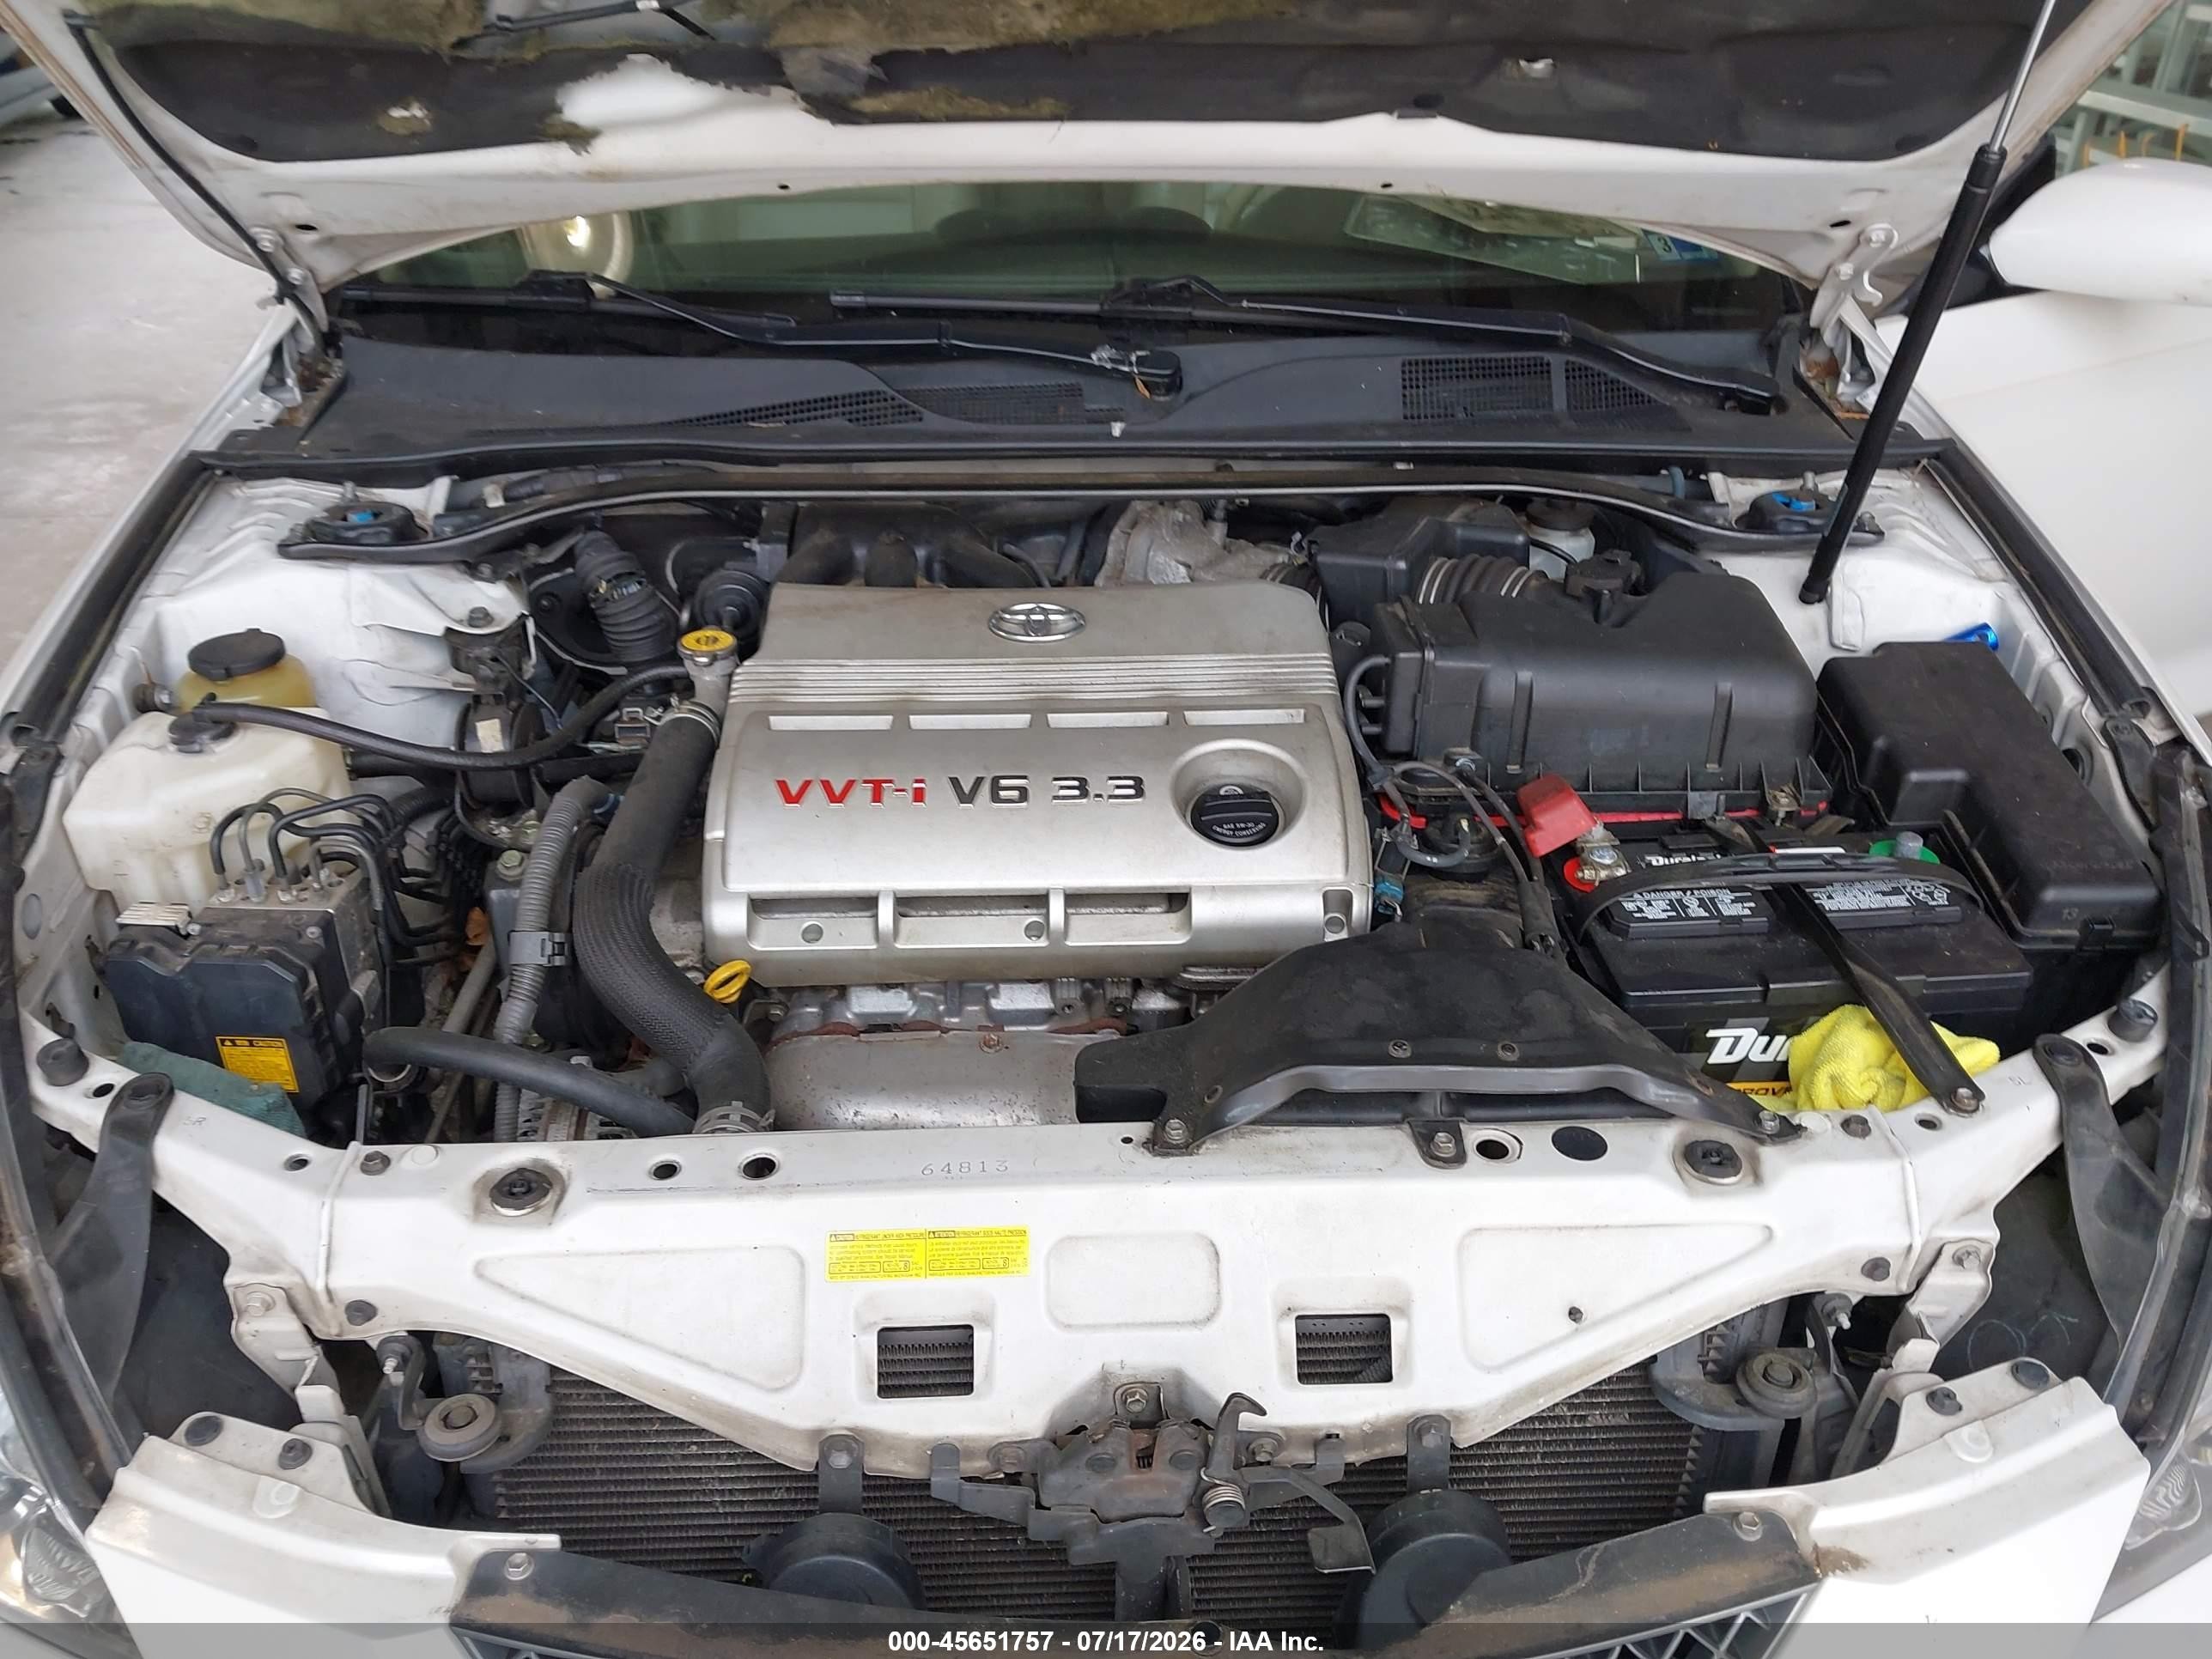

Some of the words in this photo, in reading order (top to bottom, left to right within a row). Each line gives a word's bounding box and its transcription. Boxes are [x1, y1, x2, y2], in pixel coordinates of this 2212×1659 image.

[775, 777, 927, 809] VVT-i
[947, 775, 1030, 810] V6
[1050, 775, 1146, 805] 3.3
[921, 1160, 1008, 1176] 64813
